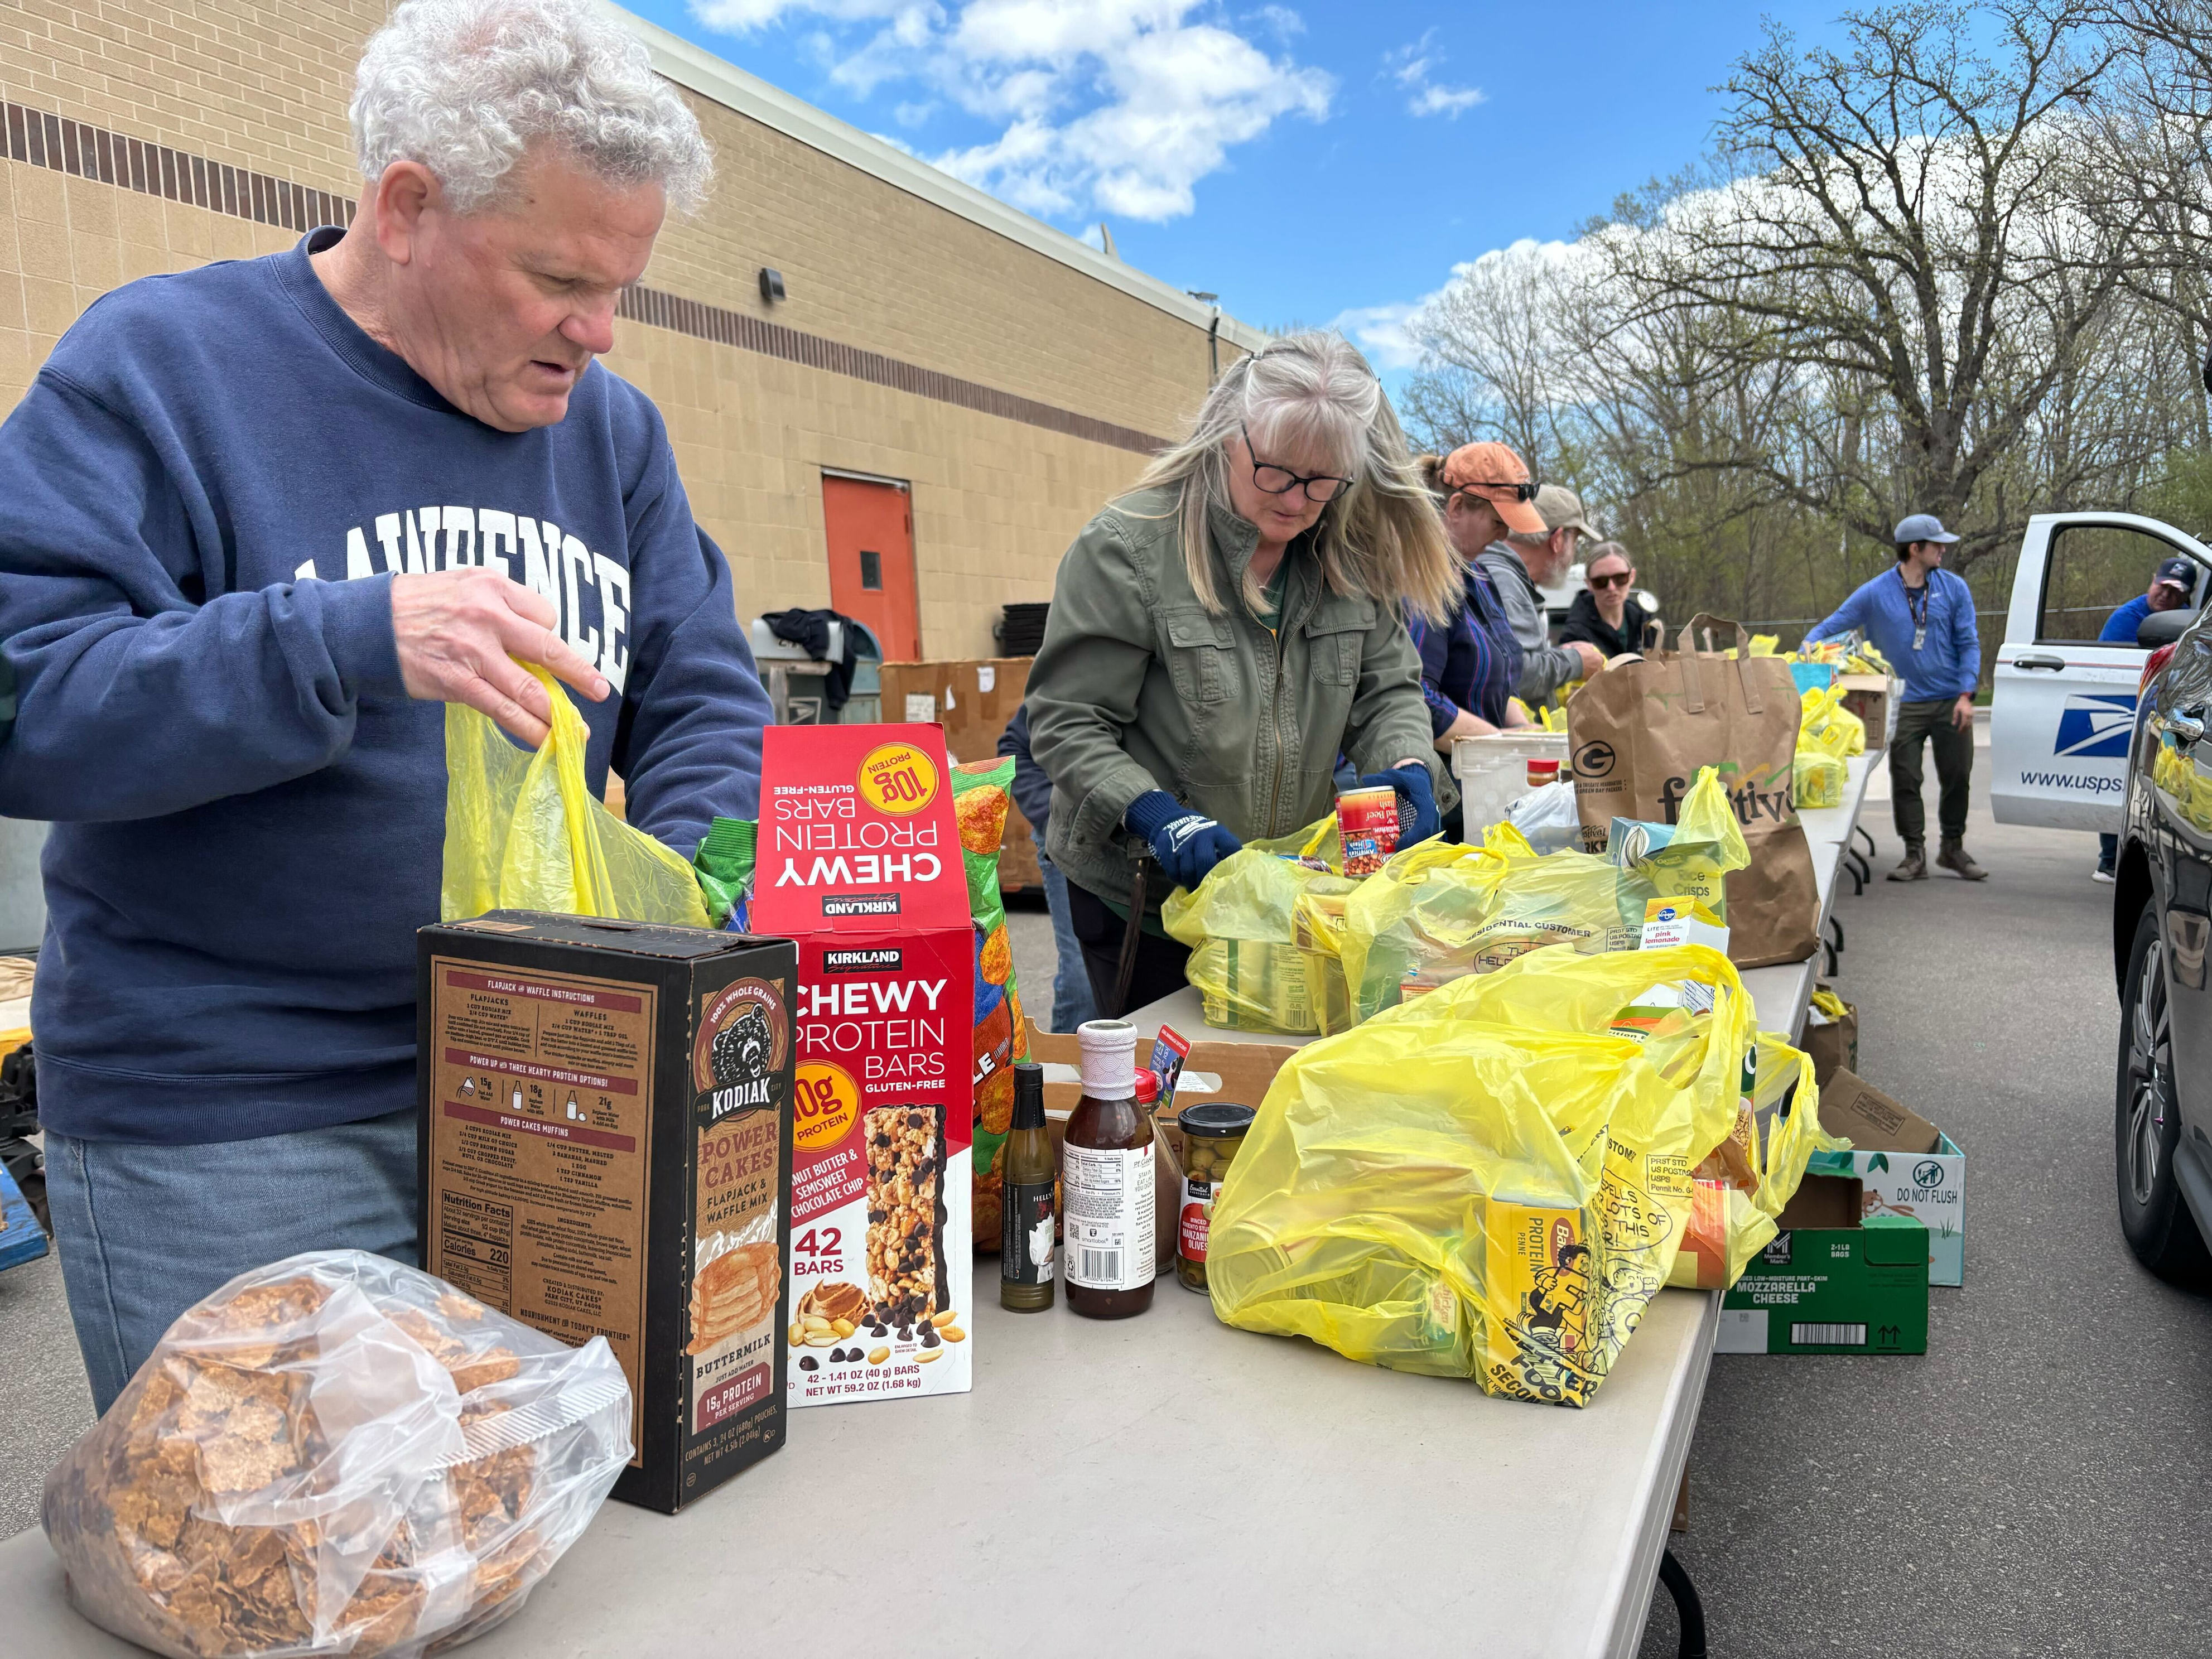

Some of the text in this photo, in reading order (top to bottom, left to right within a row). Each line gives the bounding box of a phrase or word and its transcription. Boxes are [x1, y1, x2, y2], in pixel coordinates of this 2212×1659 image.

[295, 505, 631, 696] WRENCE
[868, 752, 911, 774] PROTEIN
[773, 785, 855, 795] GLUTEN-FREE
[873, 766, 927, 804] 10g
[774, 797, 856, 821] BARS
[1366, 810, 1385, 822] Beef
[776, 820, 938, 851] PROTEIN
[774, 852, 942, 888] CHEWY
[1677, 870, 1705, 881] Rice
[1674, 884, 1710, 899] Crisps
[825, 901, 897, 914] KIRKLAND
[1657, 910, 1676, 920] Kroger
[1534, 922, 1591, 937] CUSTOMER
[828, 951, 899, 964] KIRKLAND
[828, 963, 899, 973] Signature
[470, 994, 509, 1006] FLAPJACKS
[488, 980, 595, 1004] FLAPJACK WAFFLE INSTRUCTIONS
[725, 986, 753, 1004] WHOLE
[753, 987, 777, 1010] GRAINS
[796, 979, 947, 1017] CHEWY
[574, 1009, 608, 1021] WAFFLES
[470, 1055, 608, 1087] POWER THREE HEARTY PROTEIN OPTIONS!
[865, 1052, 944, 1079] BARS
[865, 1079, 946, 1093] GLUTEN-FREE
[712, 1077, 770, 1120] KODIAK
[500, 1116, 568, 1137] POWER CAKES MUFFINS
[797, 1112, 848, 1141] PROTEIN
[701, 1121, 777, 1165] POWER
[484, 1158, 514, 1169] CHOCOLATE
[592, 1150, 614, 1159] MELTED
[814, 1148, 859, 1176] BUTTER &
[571, 1170, 602, 1181] CINNAMON
[1663, 1167, 1692, 1176] POSTAG
[575, 1179, 598, 1188] VANILLA
[707, 1178, 767, 1209] FLAPJACK &
[796, 1168, 848, 1200] SEMISWEET
[444, 1193, 510, 1218] Nutrition Facts
[791, 1177, 864, 1218] CHOCOLATE CHIP
[1897, 1188, 1958, 1204] DO NOT FLUSH
[707, 1192, 768, 1224] WAFFLE MIX
[1606, 1199, 1667, 1226] LOTS OF
[557, 1217, 592, 1229] INGREDIENTS:
[1190, 1217, 1207, 1226] MINCED
[1613, 1219, 1650, 1237] THIS
[444, 1240, 509, 1264] Calories 220
[794, 1227, 842, 1257] 42
[1188, 1240, 1208, 1252] OLIVES
[1517, 1232, 1526, 1256] PENNE
[1529, 1217, 1544, 1273] PROTEIN
[794, 1259, 844, 1276] BARS
[542, 1277, 596, 1295] CREATED DISTRIBUTED
[547, 1285, 574, 1298] KODIAK
[1736, 1282, 1815, 1293] MOZZARELLA
[558, 1302, 576, 1311] KODIAK
[1753, 1294, 1799, 1304] CHEESE
[520, 1308, 560, 1326] NOURISHMENT
[571, 1321, 595, 1334] TODAY'S
[696, 1333, 770, 1379] BUTTERMILK
[715, 1359, 754, 1383] JUST ADD WATER
[807, 1364, 920, 1383] 42 1.41 OZ (40 g) BARS
[706, 1372, 762, 1413] 15g PROTEIN
[806, 1377, 921, 1397] NET WT 59.2 OZ (1.68 kg)
[715, 1392, 754, 1419] PER SERVING
[685, 1440, 712, 1462] CONTAINS
[728, 1428, 735, 1439] OZ
[736, 1416, 753, 1436] (680g)
[754, 1404, 777, 1424] POUCHES,
[704, 1450, 714, 1465] NET
[715, 1446, 724, 1459] WT
